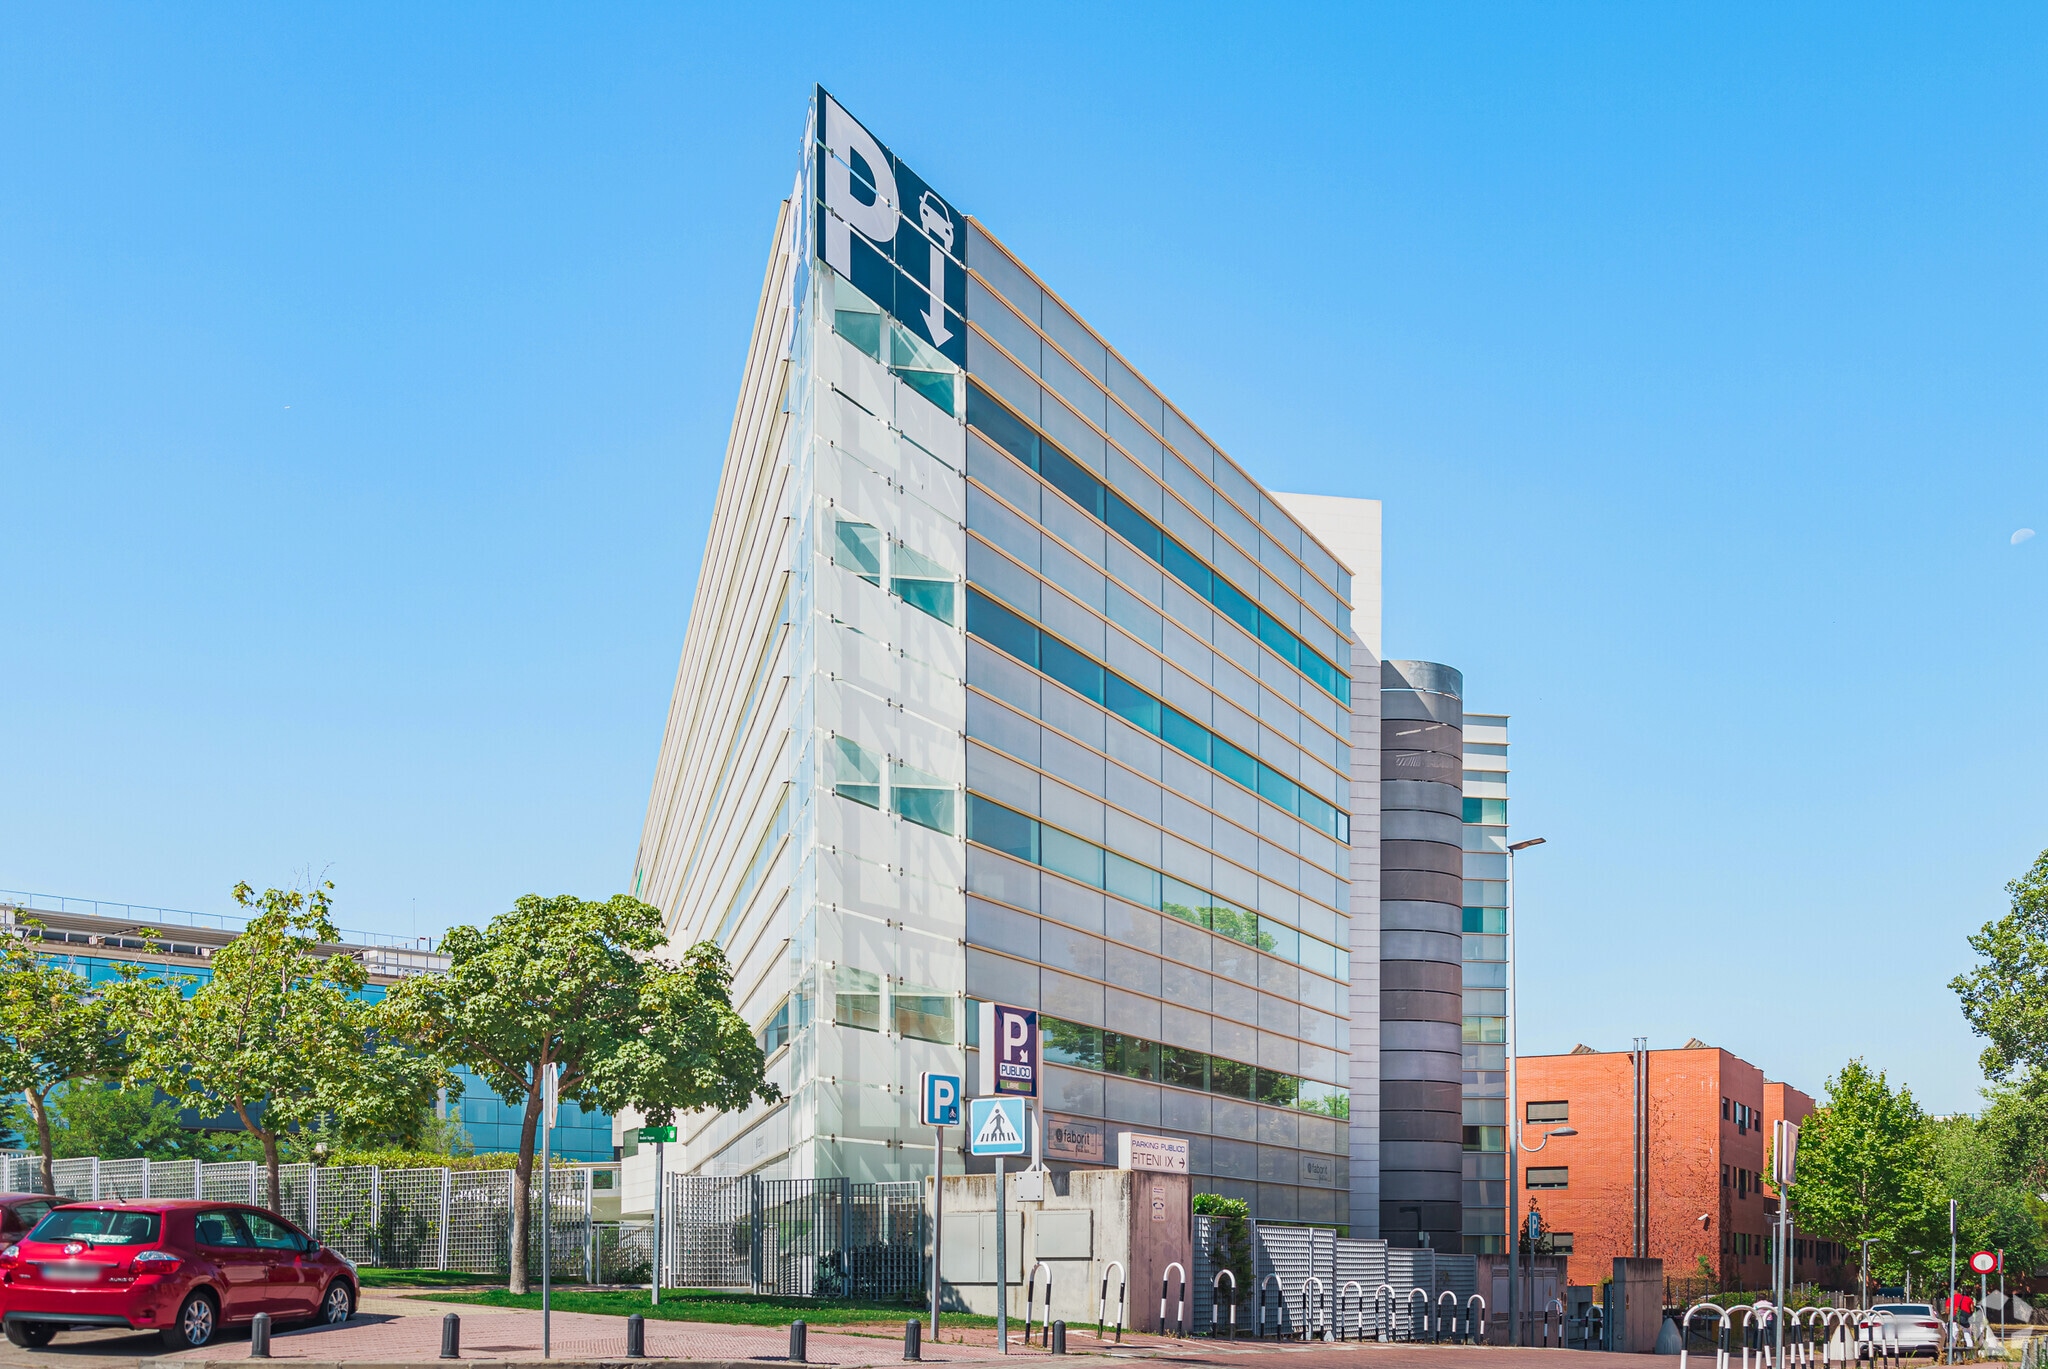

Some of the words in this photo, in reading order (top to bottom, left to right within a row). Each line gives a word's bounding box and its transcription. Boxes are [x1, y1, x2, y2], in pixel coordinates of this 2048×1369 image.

[826, 94, 899, 281] P
[1003, 1012, 1028, 1060] P
[1001, 1064, 1030, 1078] PUBLICO
[934, 1080, 955, 1119] P
[1064, 1129, 1090, 1145] faborit
[1132, 1140, 1159, 1150] PARKING
[1161, 1143, 1186, 1153] PUBLICO
[1132, 1152, 1162, 1167] FITENI
[1164, 1155, 1174, 1168] IX
[1532, 1215, 1538, 1236] P
